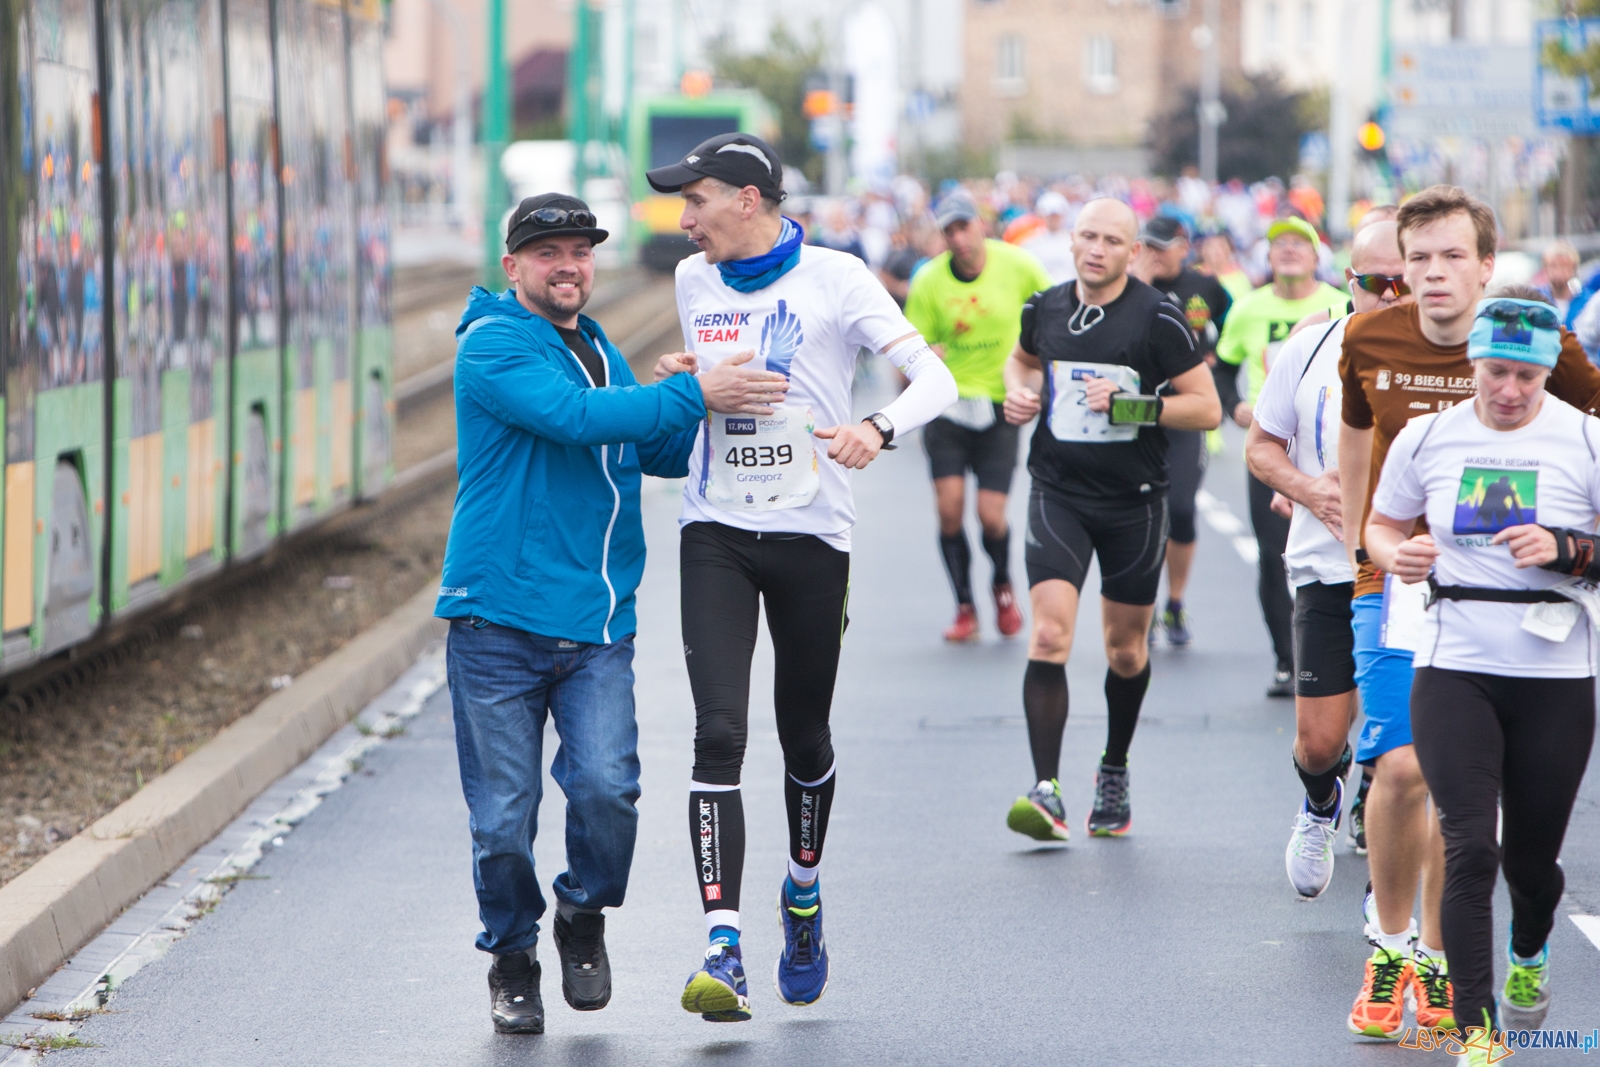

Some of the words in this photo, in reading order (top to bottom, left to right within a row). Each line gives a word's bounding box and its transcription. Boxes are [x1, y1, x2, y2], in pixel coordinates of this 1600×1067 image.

[694, 312, 751, 327] HERNIK
[697, 328, 740, 342] TEAM
[1394, 373, 1412, 386] 39
[1413, 374, 1445, 387] BIEG
[725, 444, 793, 467] 4839
[1465, 456, 1502, 466] AKADEMIA
[1505, 460, 1540, 468] BIEGANIA
[736, 473, 783, 483] Grzegorz
